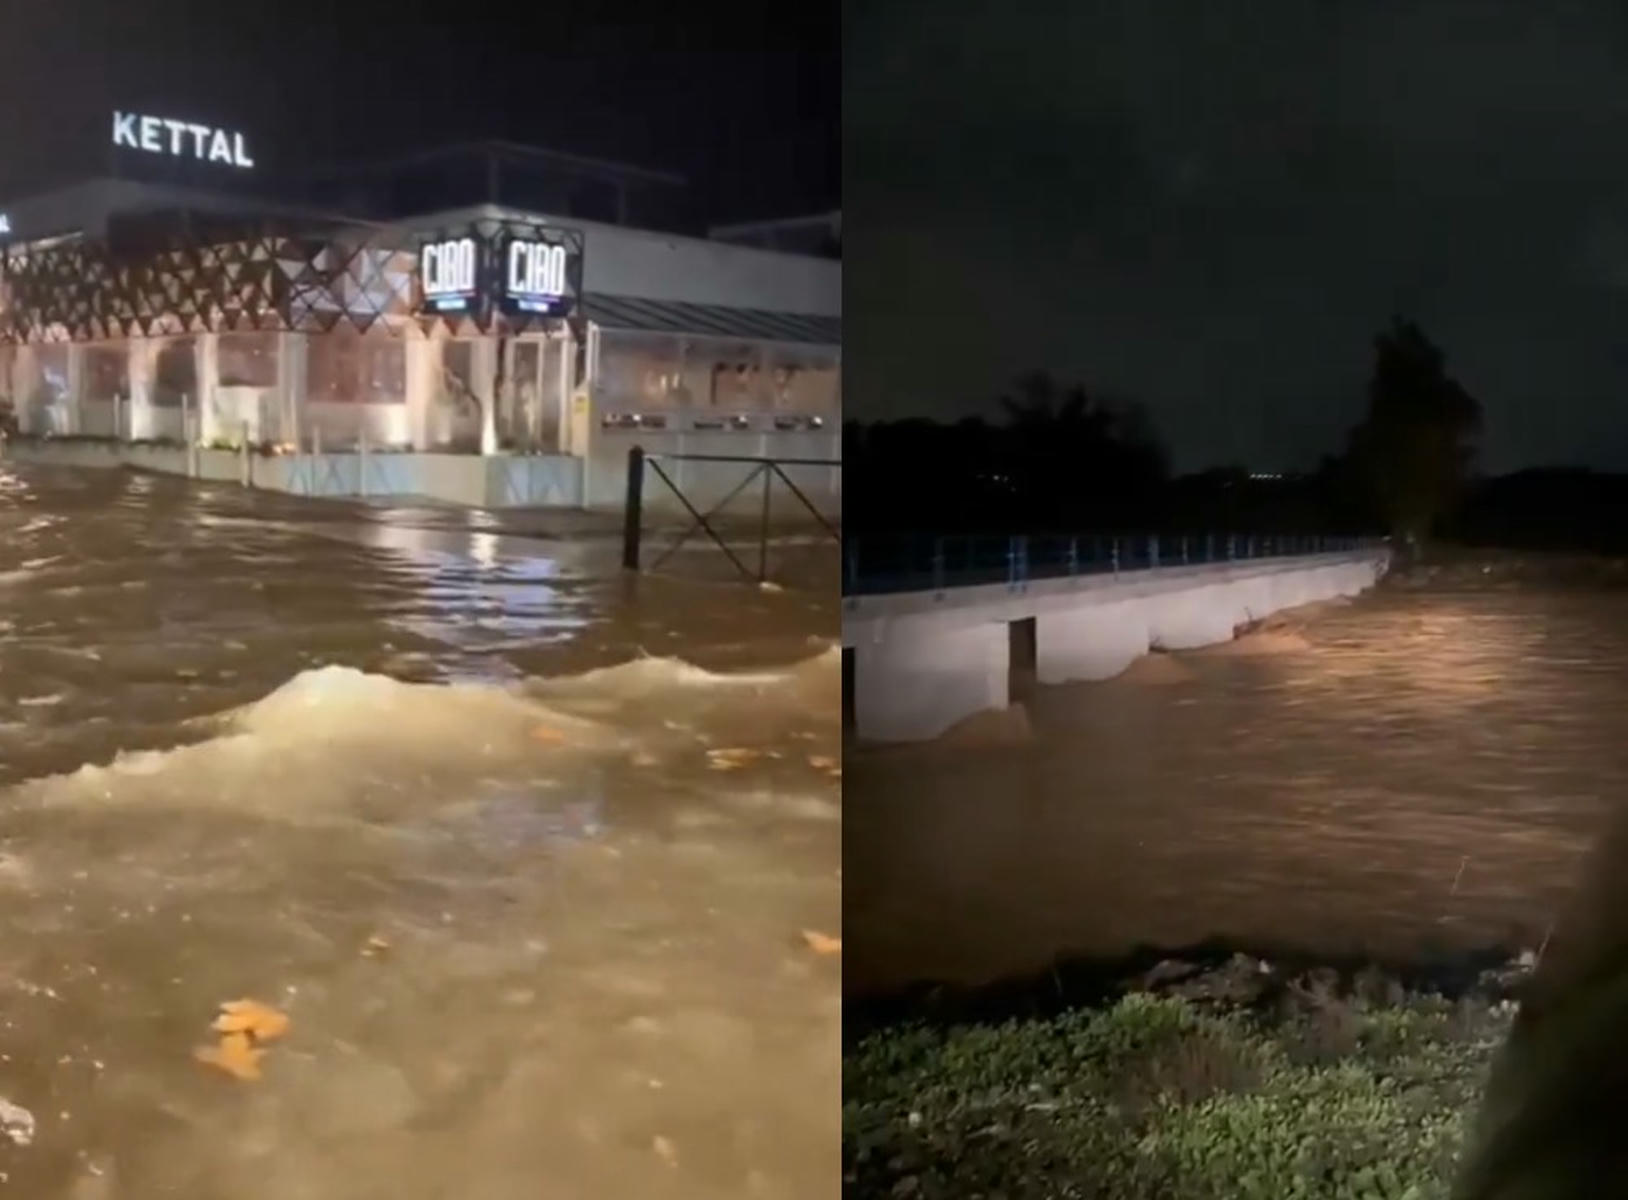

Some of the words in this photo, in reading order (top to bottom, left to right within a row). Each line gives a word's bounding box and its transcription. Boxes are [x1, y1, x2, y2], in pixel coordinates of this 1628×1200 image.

[112, 110, 254, 167] KETTAL
[423, 238, 475, 294] CIBO
[509, 240, 566, 295] CIBO
